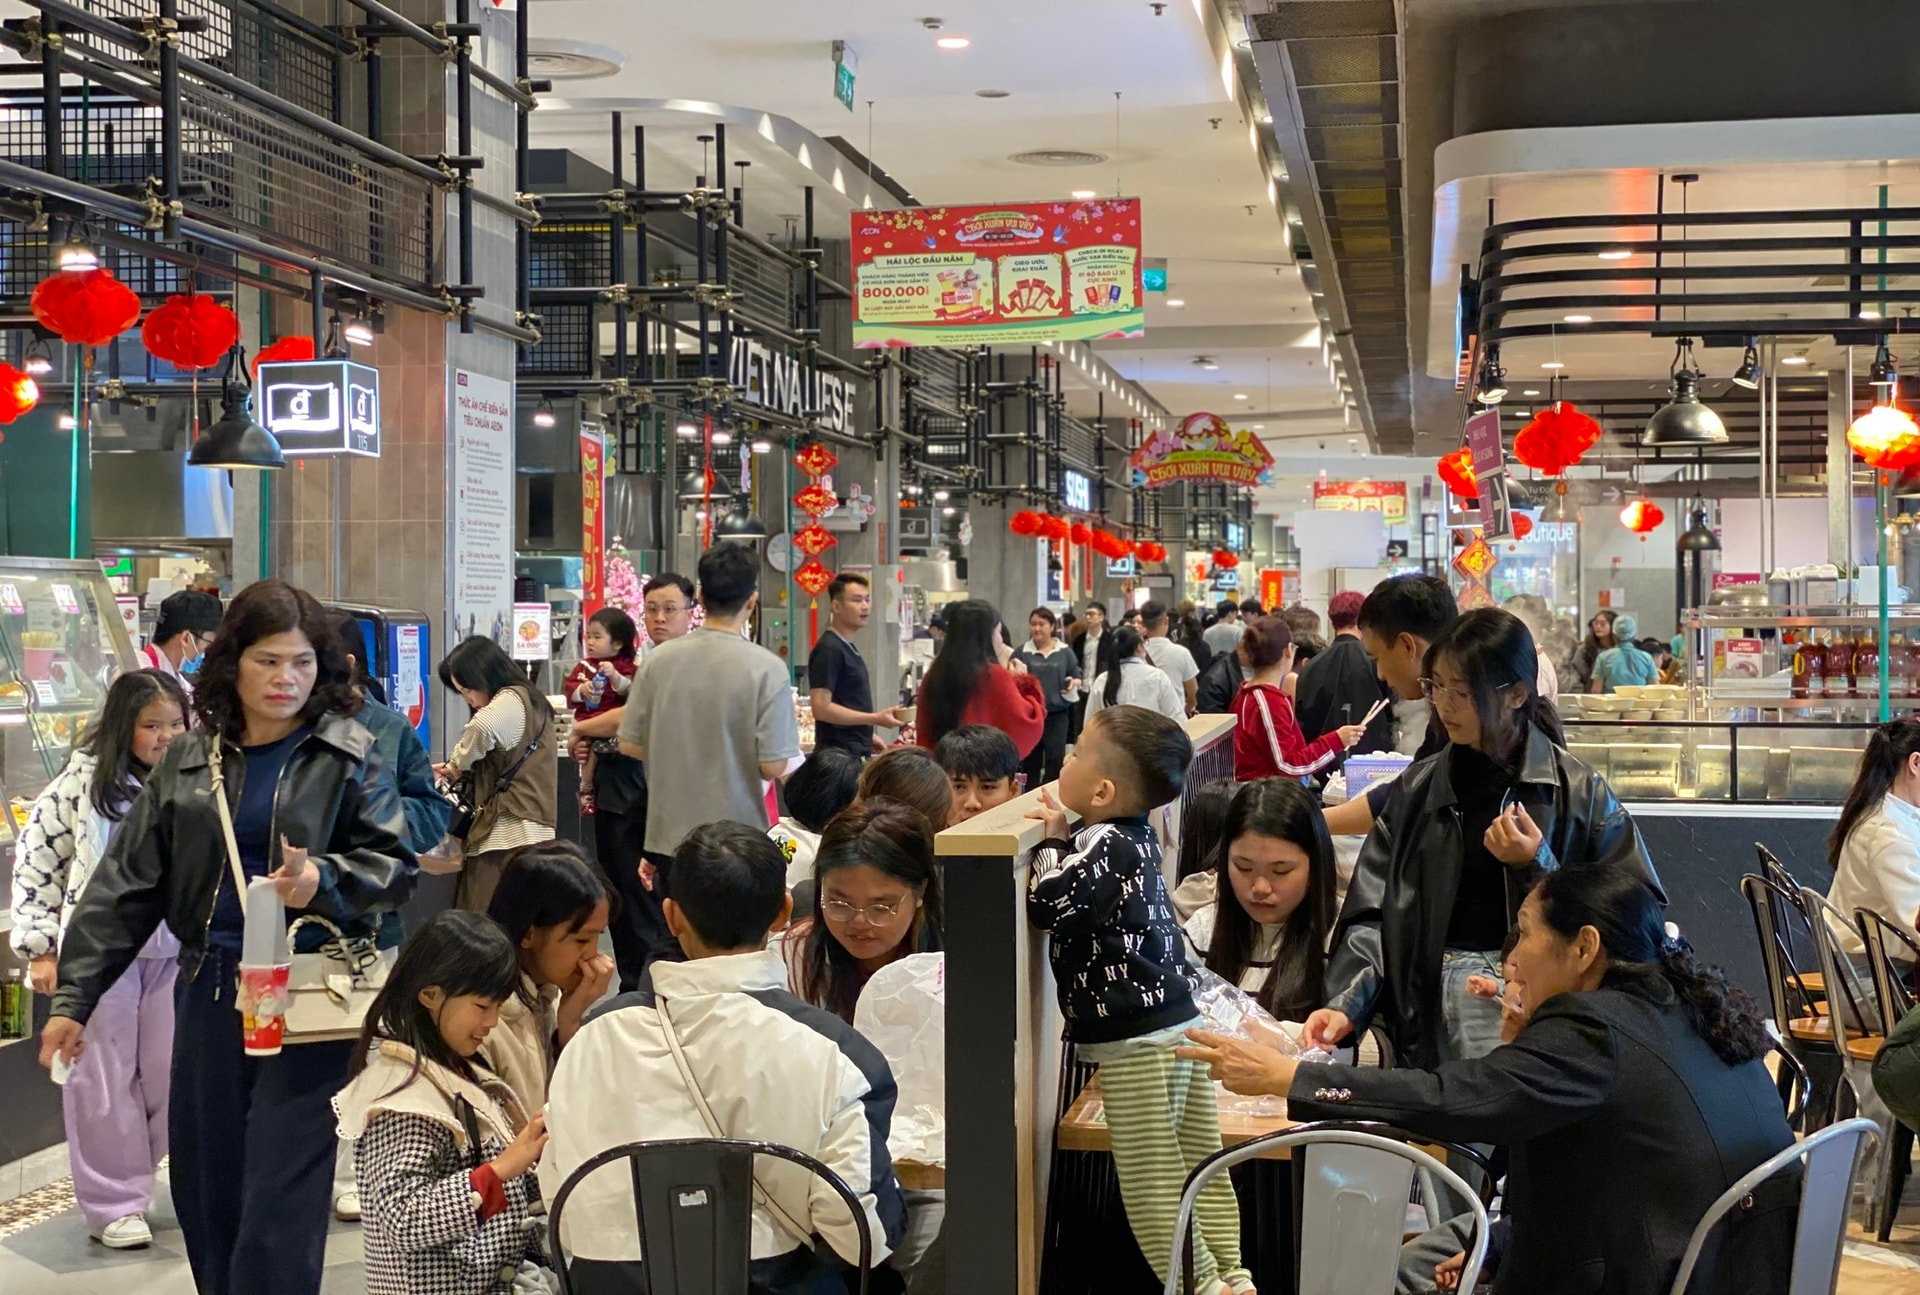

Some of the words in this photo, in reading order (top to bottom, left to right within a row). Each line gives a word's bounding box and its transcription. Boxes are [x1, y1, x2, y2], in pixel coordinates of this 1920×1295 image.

[886, 256, 902, 265] HÁI
[904, 256, 921, 266] LỘC
[943, 254, 963, 263] NĂM
[1212, 462, 1231, 476] VUI
[1093, 857, 1110, 879] NY
[1121, 875, 1145, 895] NY
[1055, 895, 1076, 918] NY
[1124, 934, 1145, 951] NY
[1104, 963, 1128, 982] NY
[1142, 988, 1165, 1007] NY
